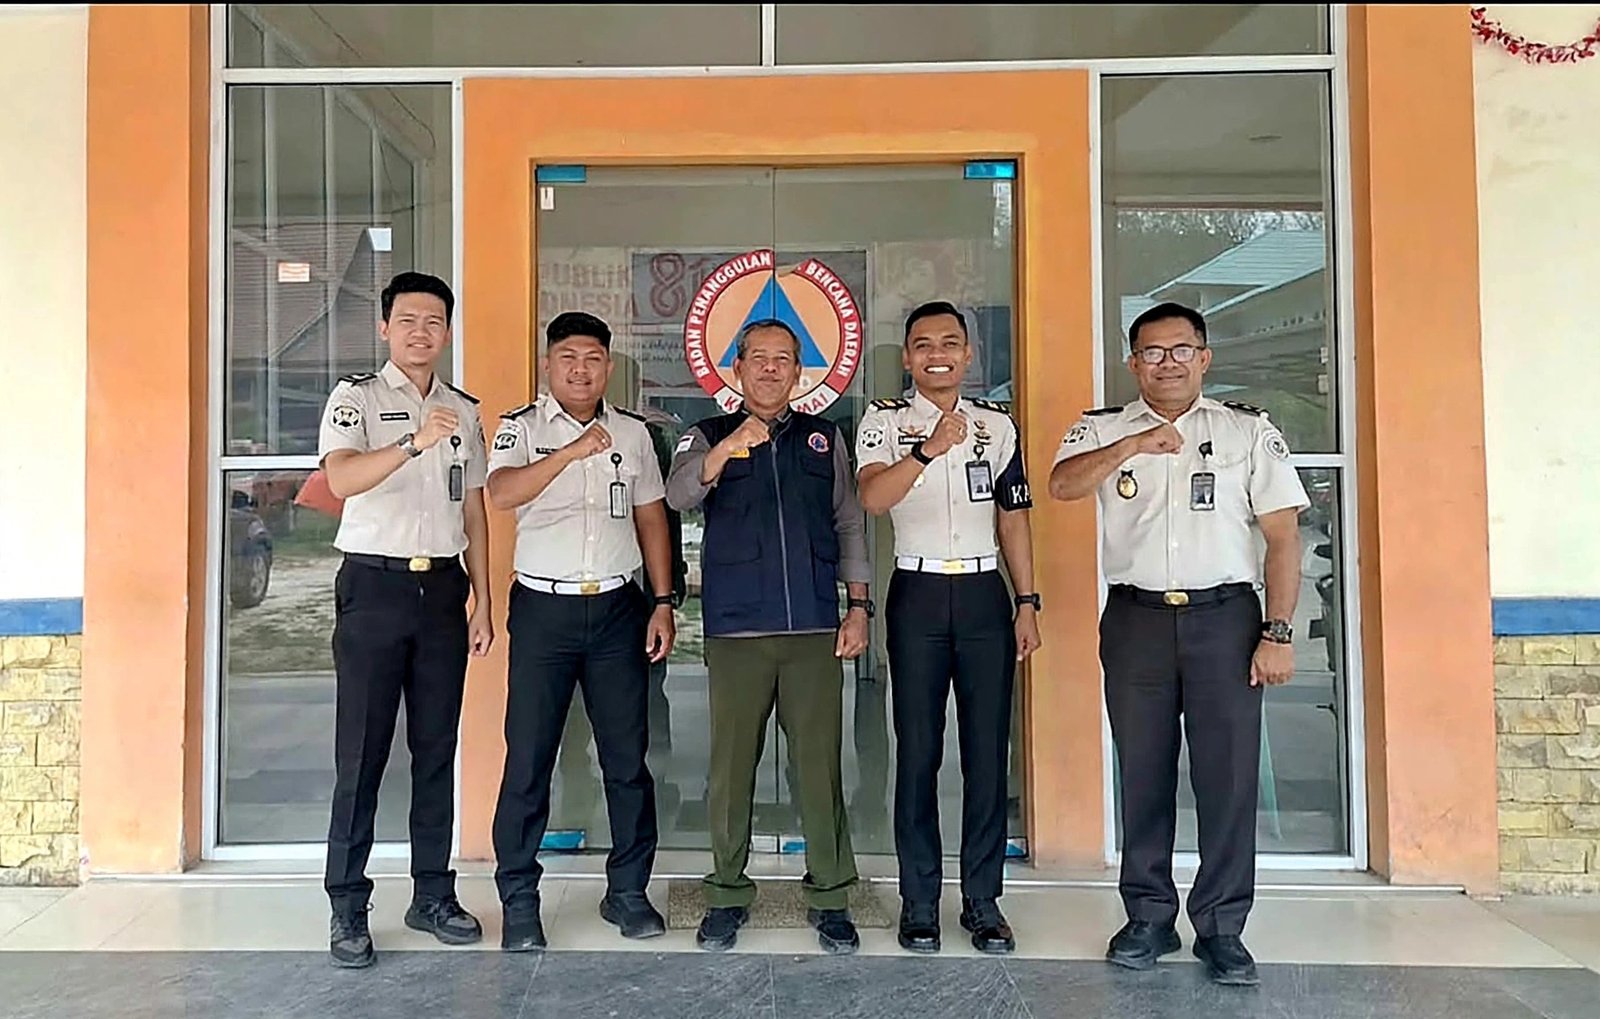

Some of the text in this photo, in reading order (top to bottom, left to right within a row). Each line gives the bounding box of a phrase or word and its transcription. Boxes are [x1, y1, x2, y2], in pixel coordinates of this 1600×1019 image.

[687, 251, 859, 378] BADAN PENANGGULAN BENCANA DAERAH
